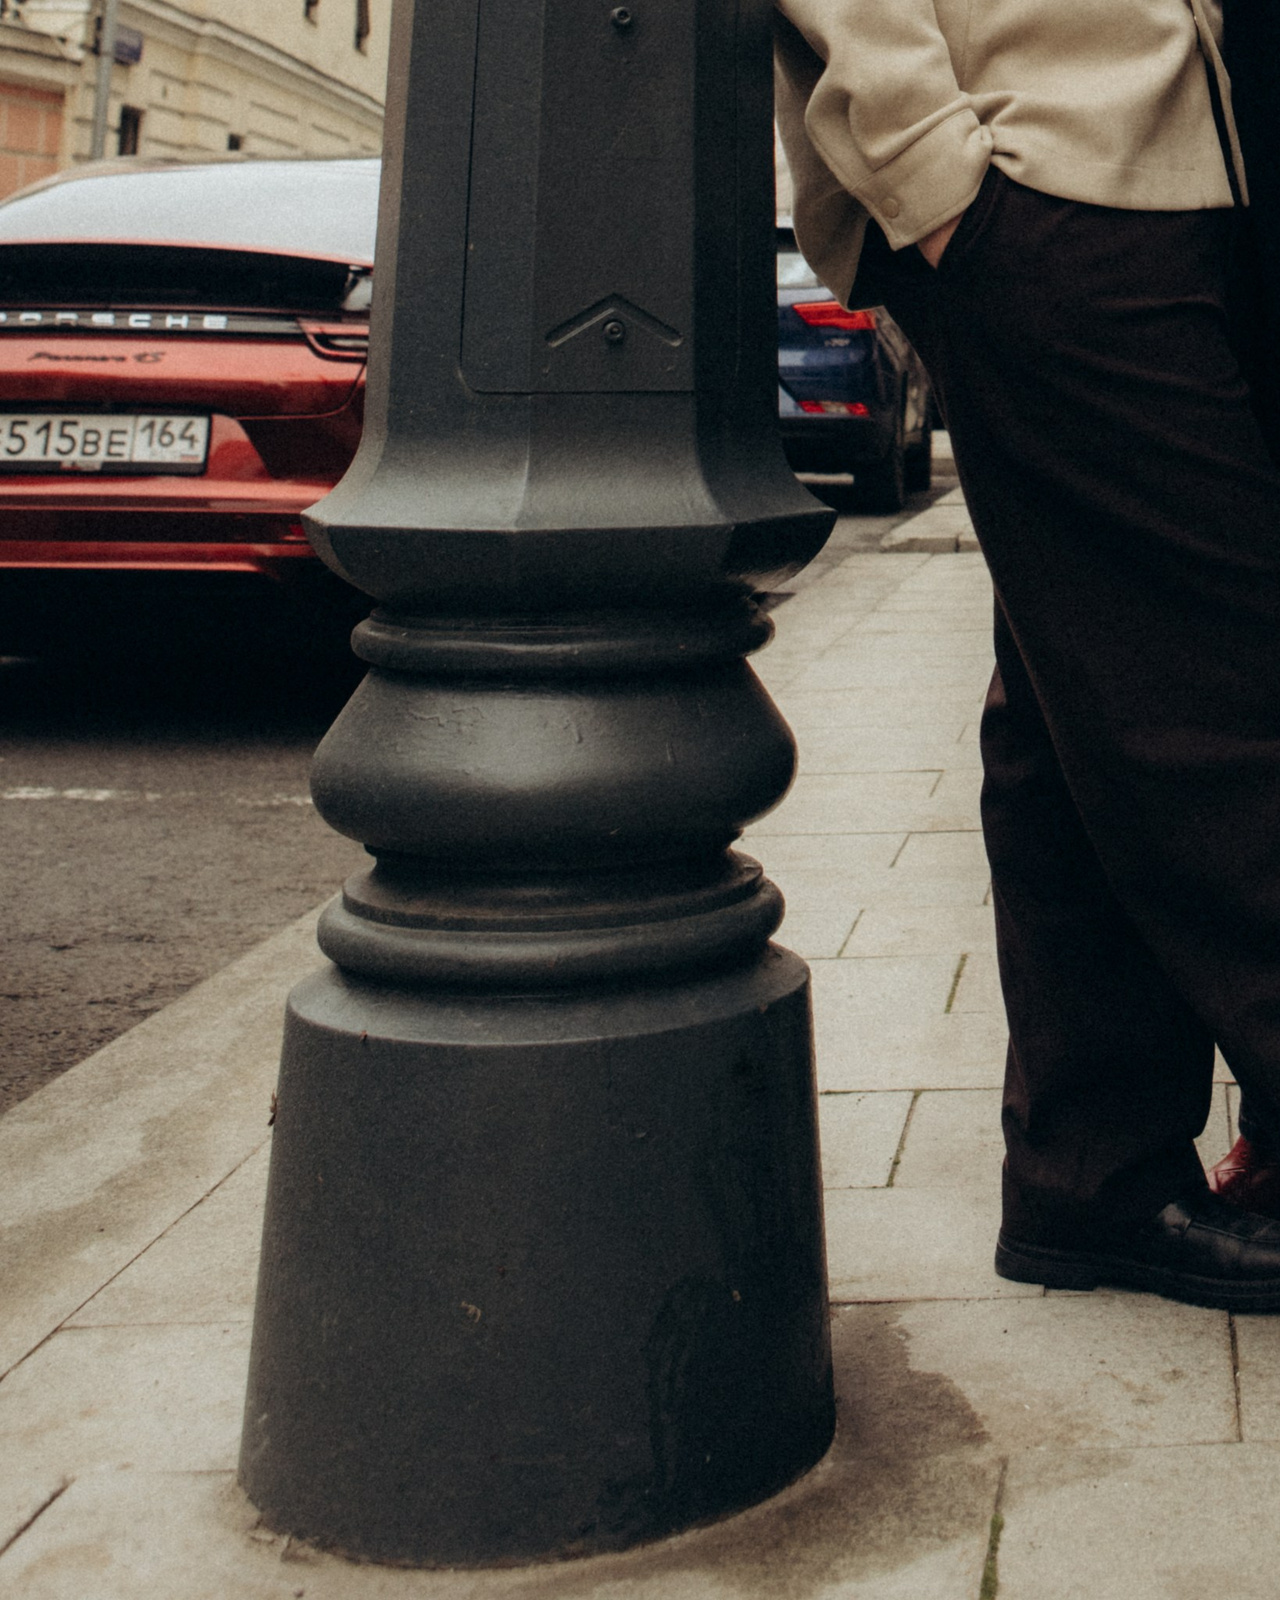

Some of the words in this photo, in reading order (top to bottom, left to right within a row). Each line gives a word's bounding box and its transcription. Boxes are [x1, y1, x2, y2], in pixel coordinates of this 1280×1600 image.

[0, 312, 228, 329] ORSCHE
[0, 420, 128, 457] 515BE
[140, 420, 199, 449] 164
